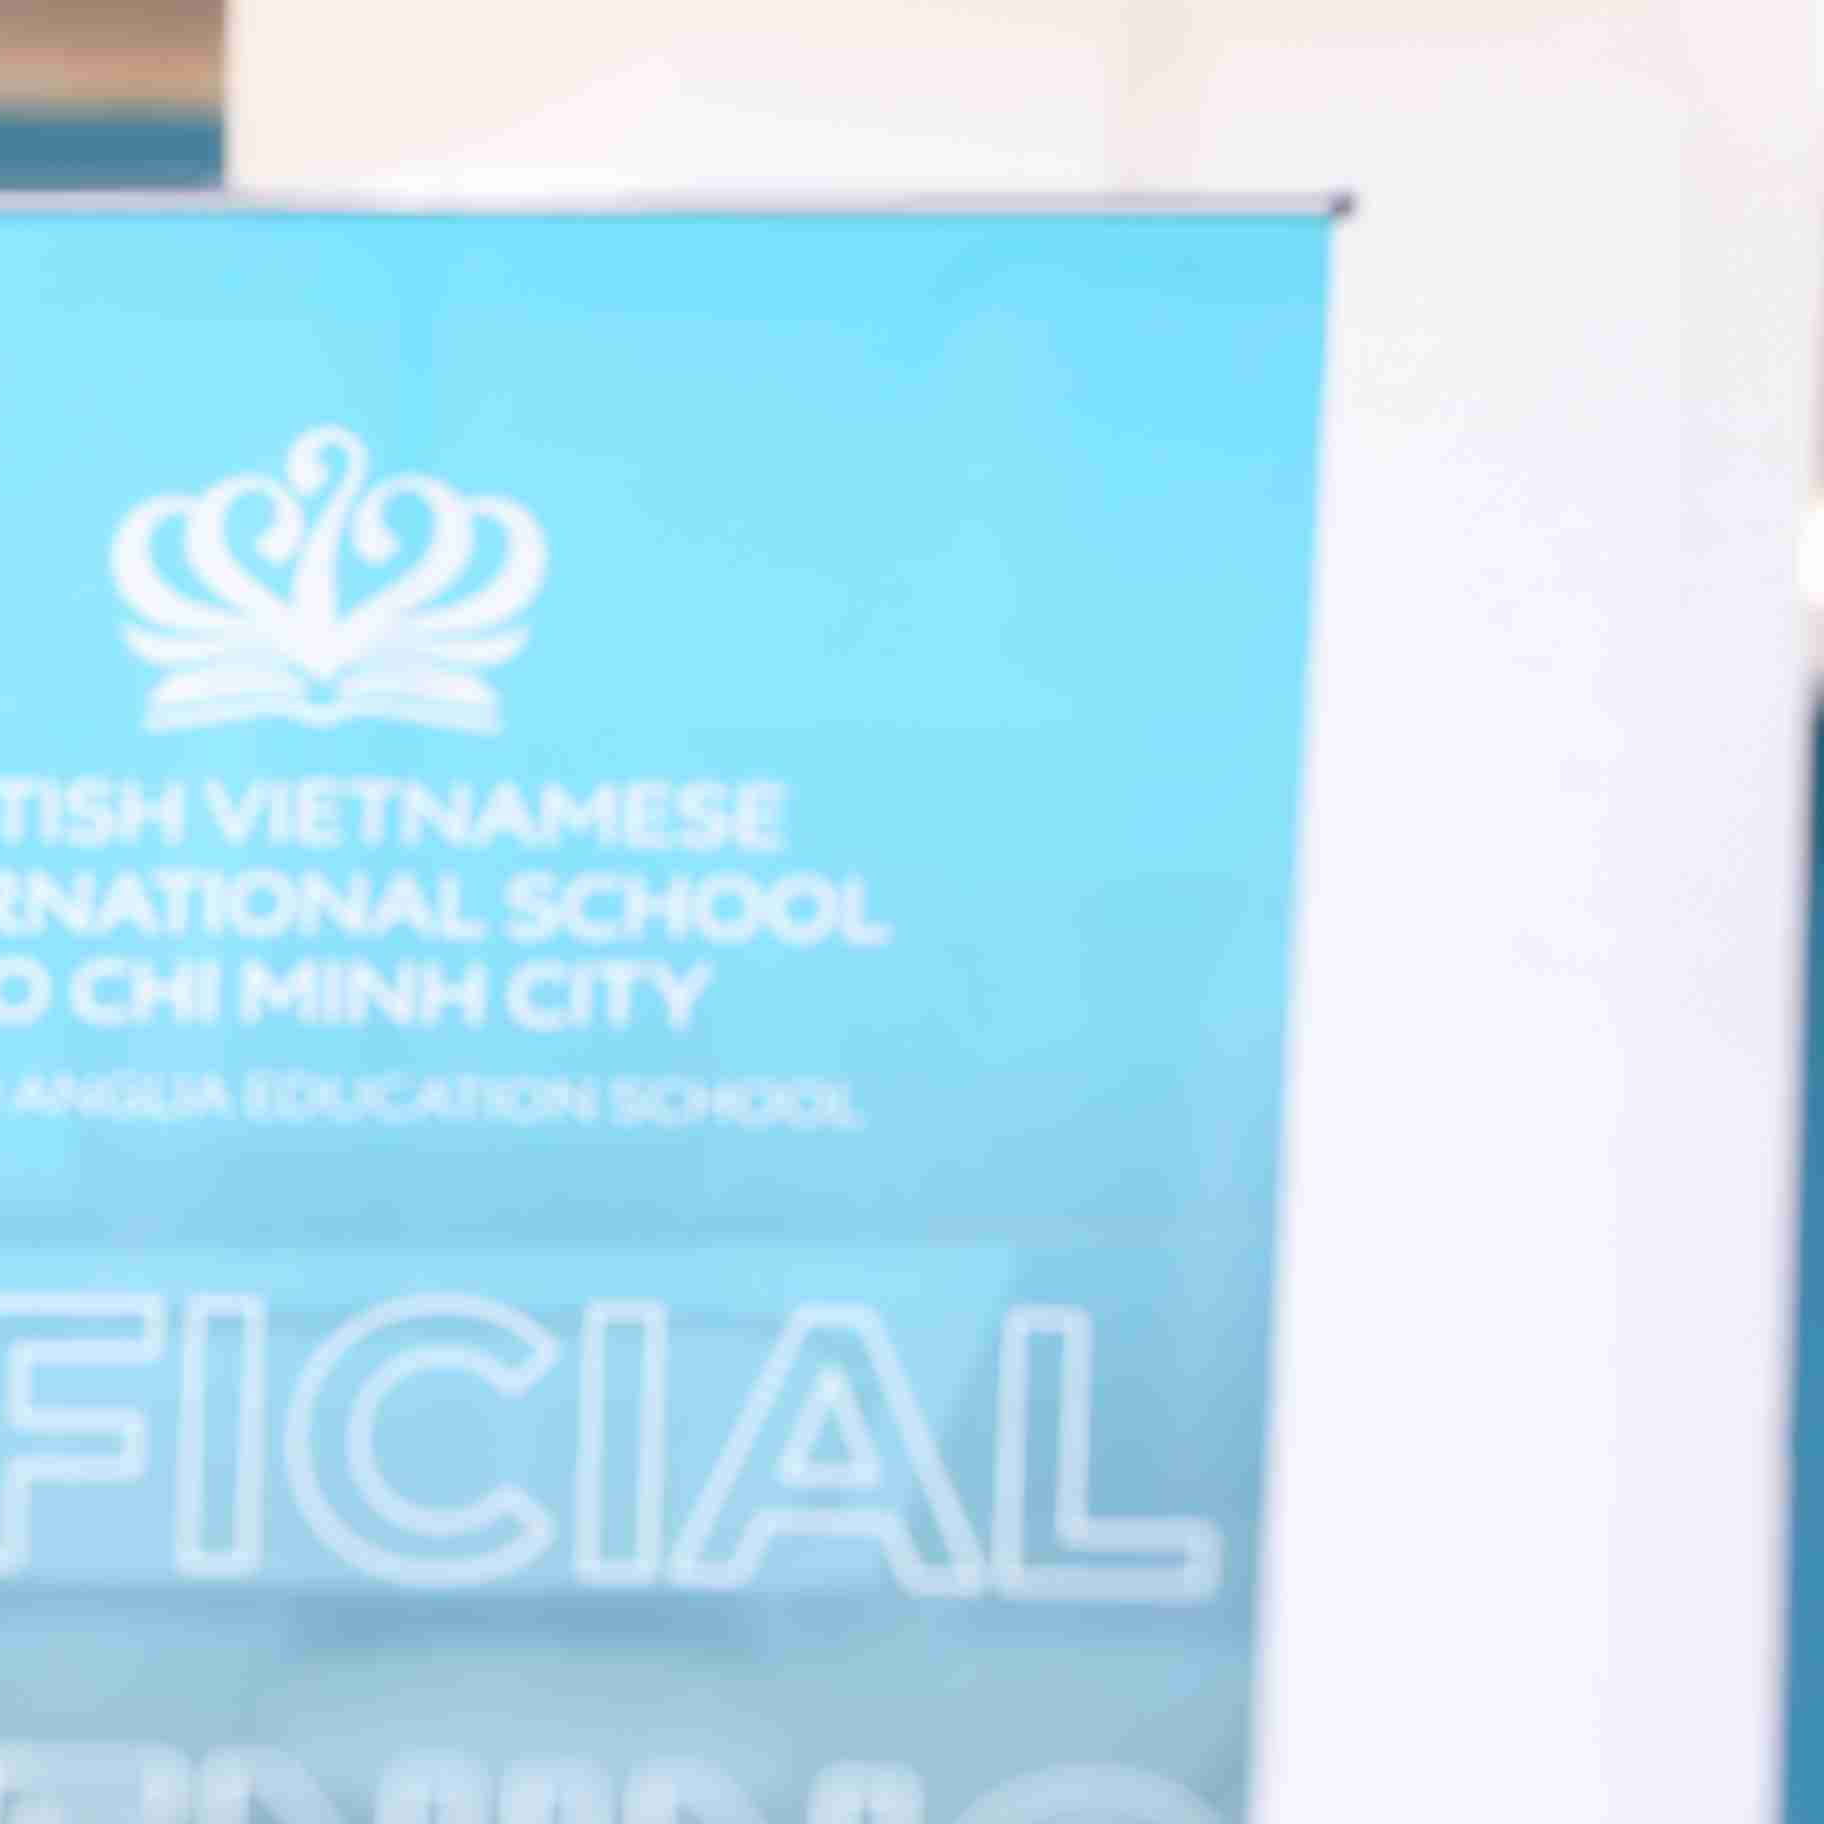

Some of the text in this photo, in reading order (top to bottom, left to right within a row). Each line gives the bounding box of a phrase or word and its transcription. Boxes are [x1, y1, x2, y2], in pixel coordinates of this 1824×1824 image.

[205, 777, 788, 853] VIETNAMESE
[503, 872, 894, 946] SCHOOL
[71, 960, 221, 1026] CHI
[241, 960, 488, 1028] MINH
[508, 963, 710, 1032] CITY
[14, 1070, 232, 1120] ANGLIA
[244, 1072, 600, 1125] EDUCATION
[610, 1077, 866, 1131] SCHOOL
